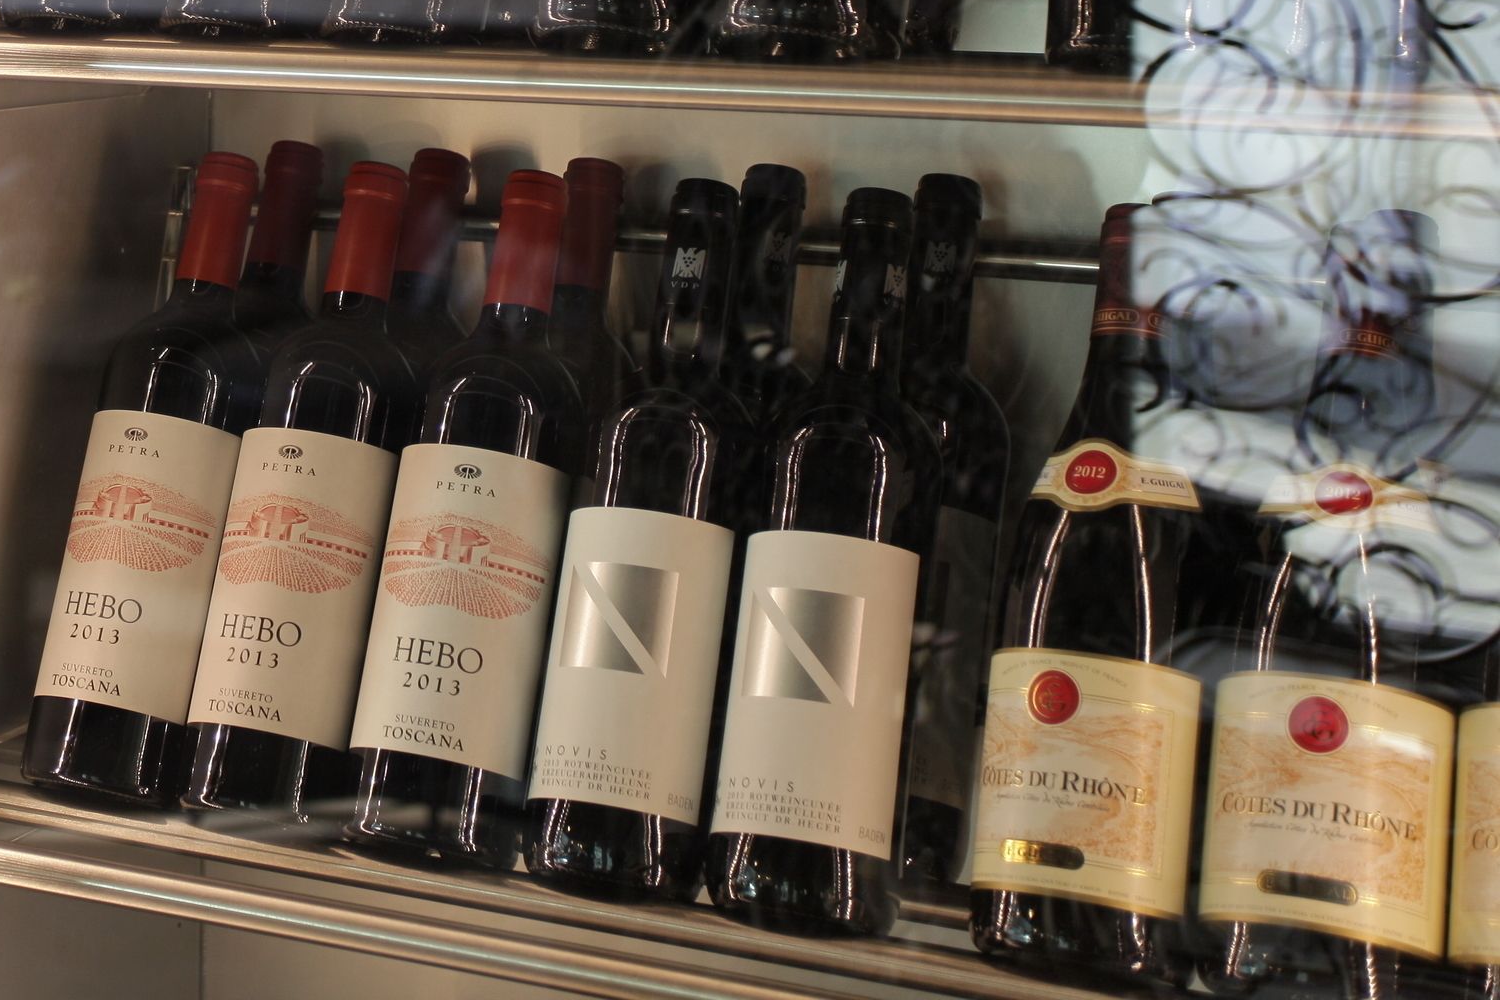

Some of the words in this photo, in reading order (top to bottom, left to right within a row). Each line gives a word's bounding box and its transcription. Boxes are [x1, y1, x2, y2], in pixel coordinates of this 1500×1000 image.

[108, 444, 160, 459] PETRA
[261, 462, 317, 477] PETRA
[1073, 466, 1107, 479] 2012
[436, 480, 496, 498] PETRA
[1325, 486, 1360, 500] 2012
[65, 590, 143, 624] HEBO
[69, 623, 120, 645] 2013
[220, 613, 302, 647] HEBO
[226, 646, 279, 669] 2013
[394, 636, 483, 674] HEBO
[61, 662, 113, 678] SUVERETO
[51, 673, 121, 697] TOSCANA
[403, 672, 460, 696] 2013
[218, 687, 273, 704] SUVERETO
[208, 698, 282, 722] TOSCANA
[395, 713, 455, 732] SUVERETO
[383, 725, 465, 752] TOSCANA
[545, 744, 607, 761] NOVIS
[541, 778, 583, 789] WEINGUT
[609, 786, 651, 800] HEGER
[729, 777, 795, 793] NOVIS
[1029, 770, 1056, 787] DU
[1061, 770, 1146, 806] RHÔNE
[668, 793, 694, 811] BADEN
[726, 812, 769, 822] WEINGUT
[798, 818, 841, 834] HEGER
[1292, 801, 1325, 822] DU
[1332, 801, 1417, 842] RHÔNE
[859, 826, 885, 844] BADEN
